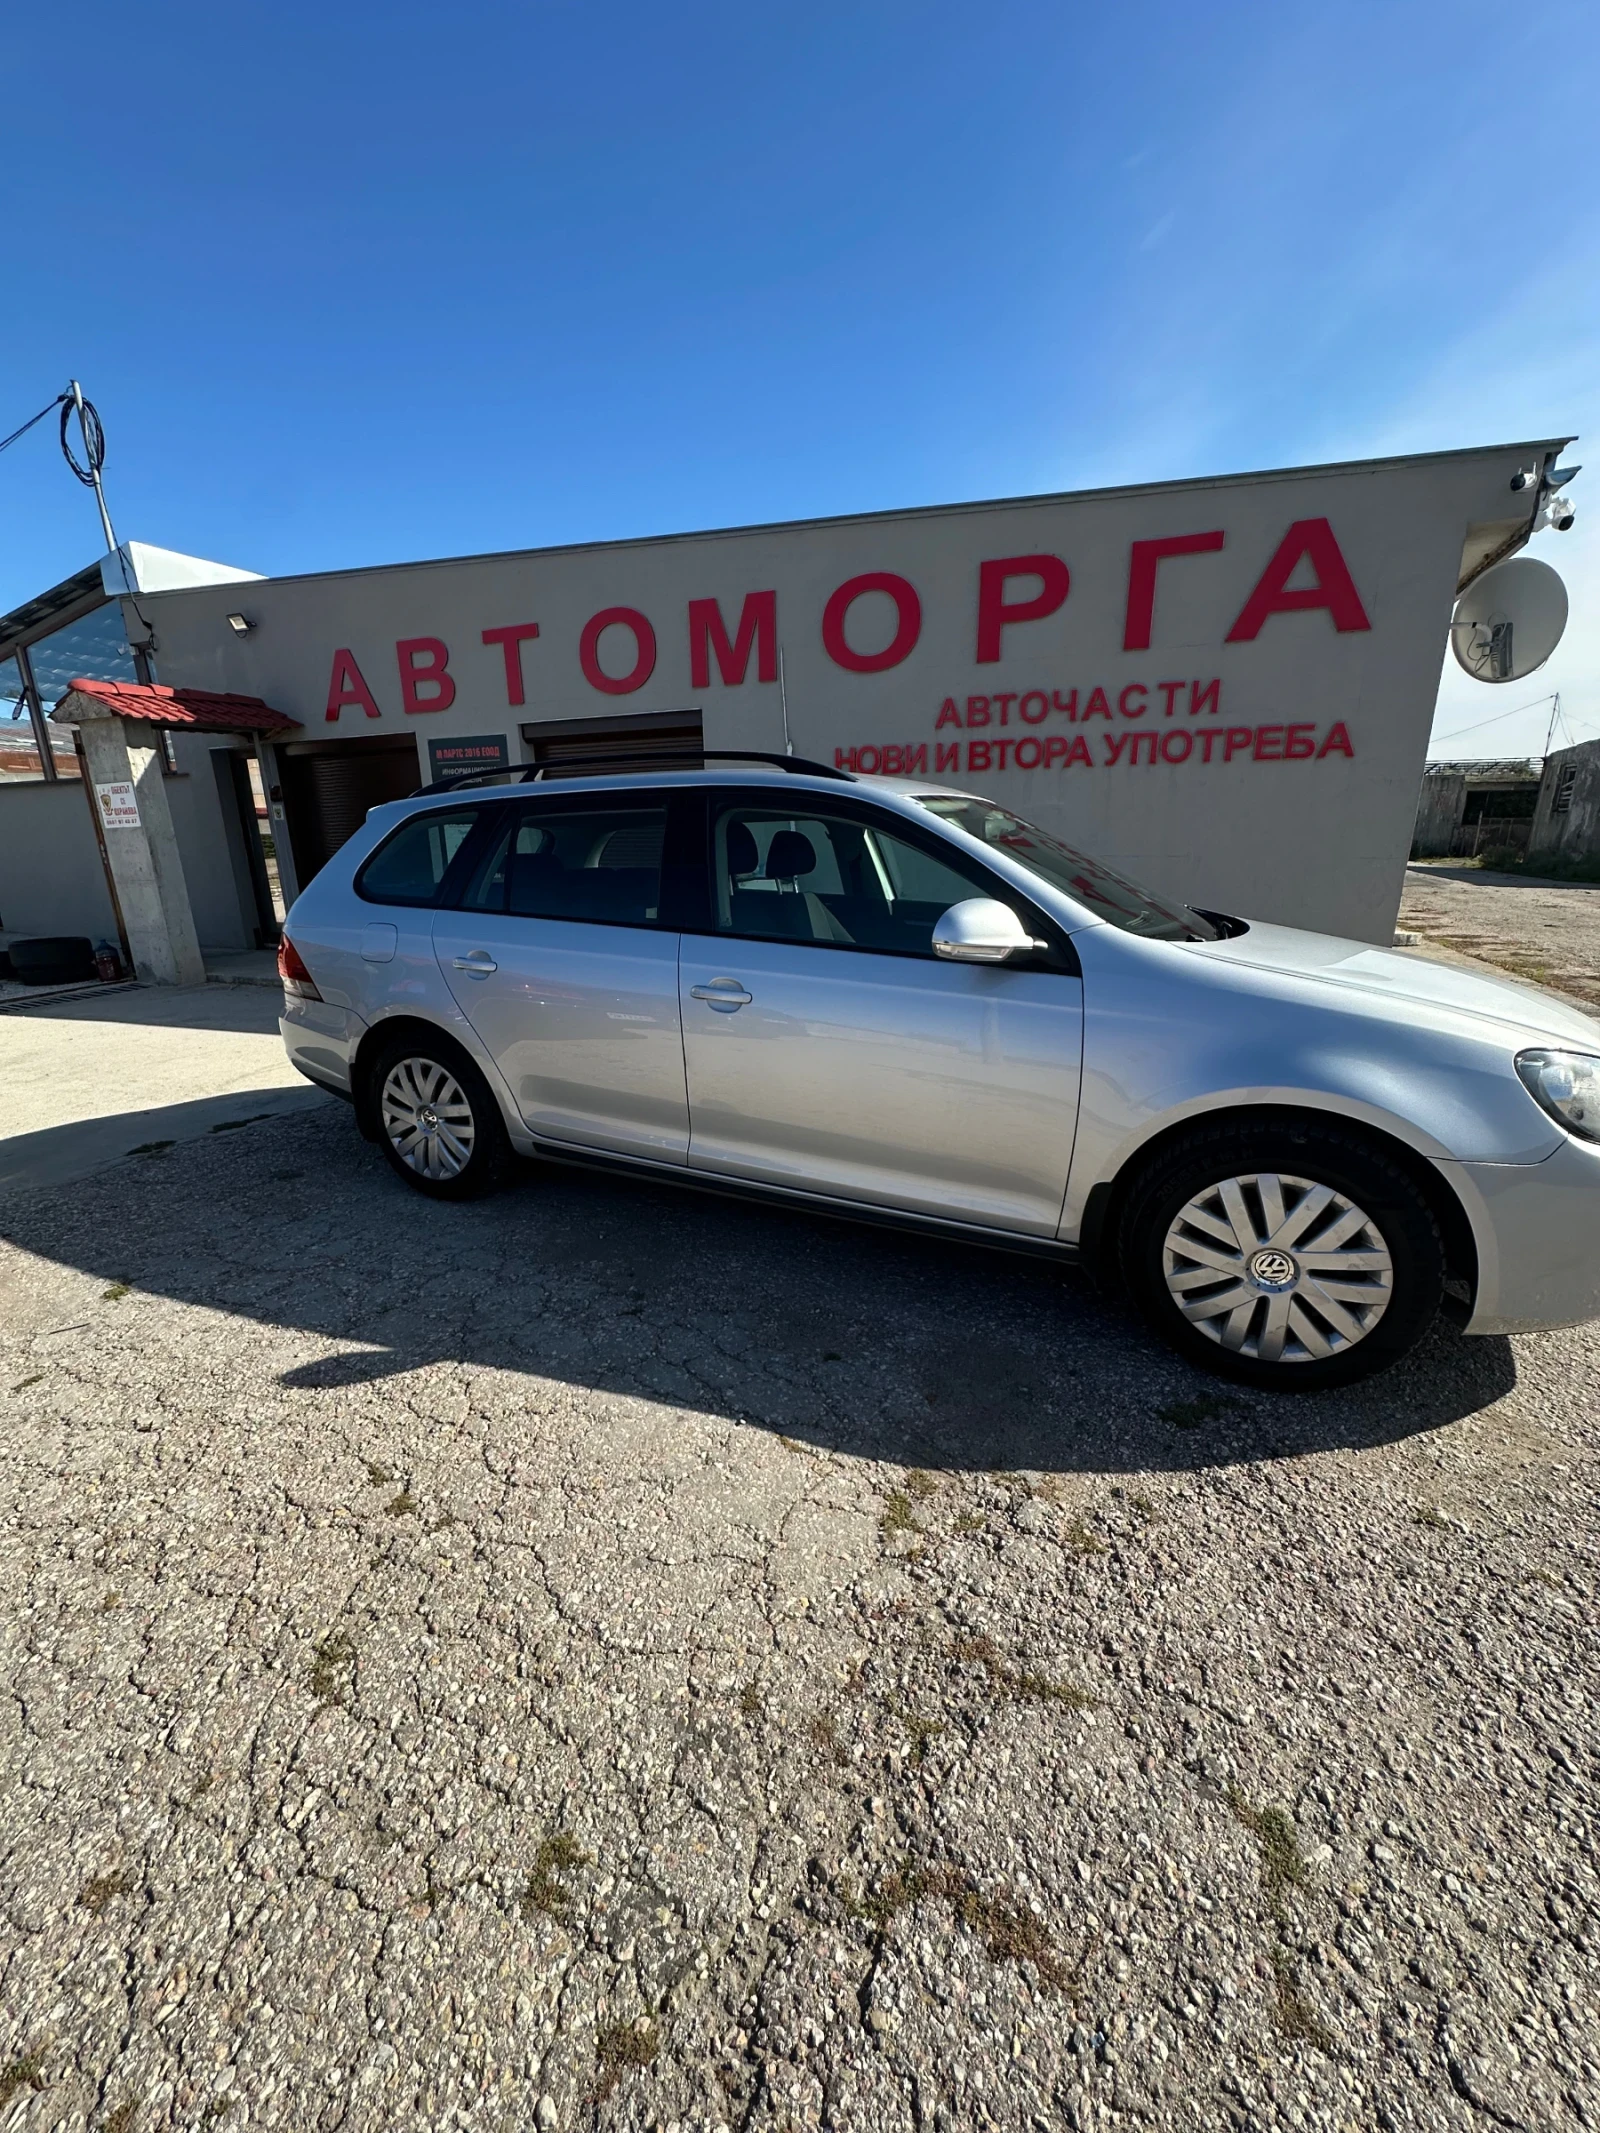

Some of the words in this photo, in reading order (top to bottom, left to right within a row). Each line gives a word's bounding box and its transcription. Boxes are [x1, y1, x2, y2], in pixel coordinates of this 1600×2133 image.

[325, 517, 1371, 721] АВТОМОРГА
[936, 678, 1221, 729] АВТОЧАСТИ
[481, 746, 500, 757] ЕООД
[835, 743, 926, 775] НОВИ
[936, 742, 959, 773] И
[967, 735, 1093, 772] ВТОРА
[1104, 722, 1354, 766] УПОТРЕБА
